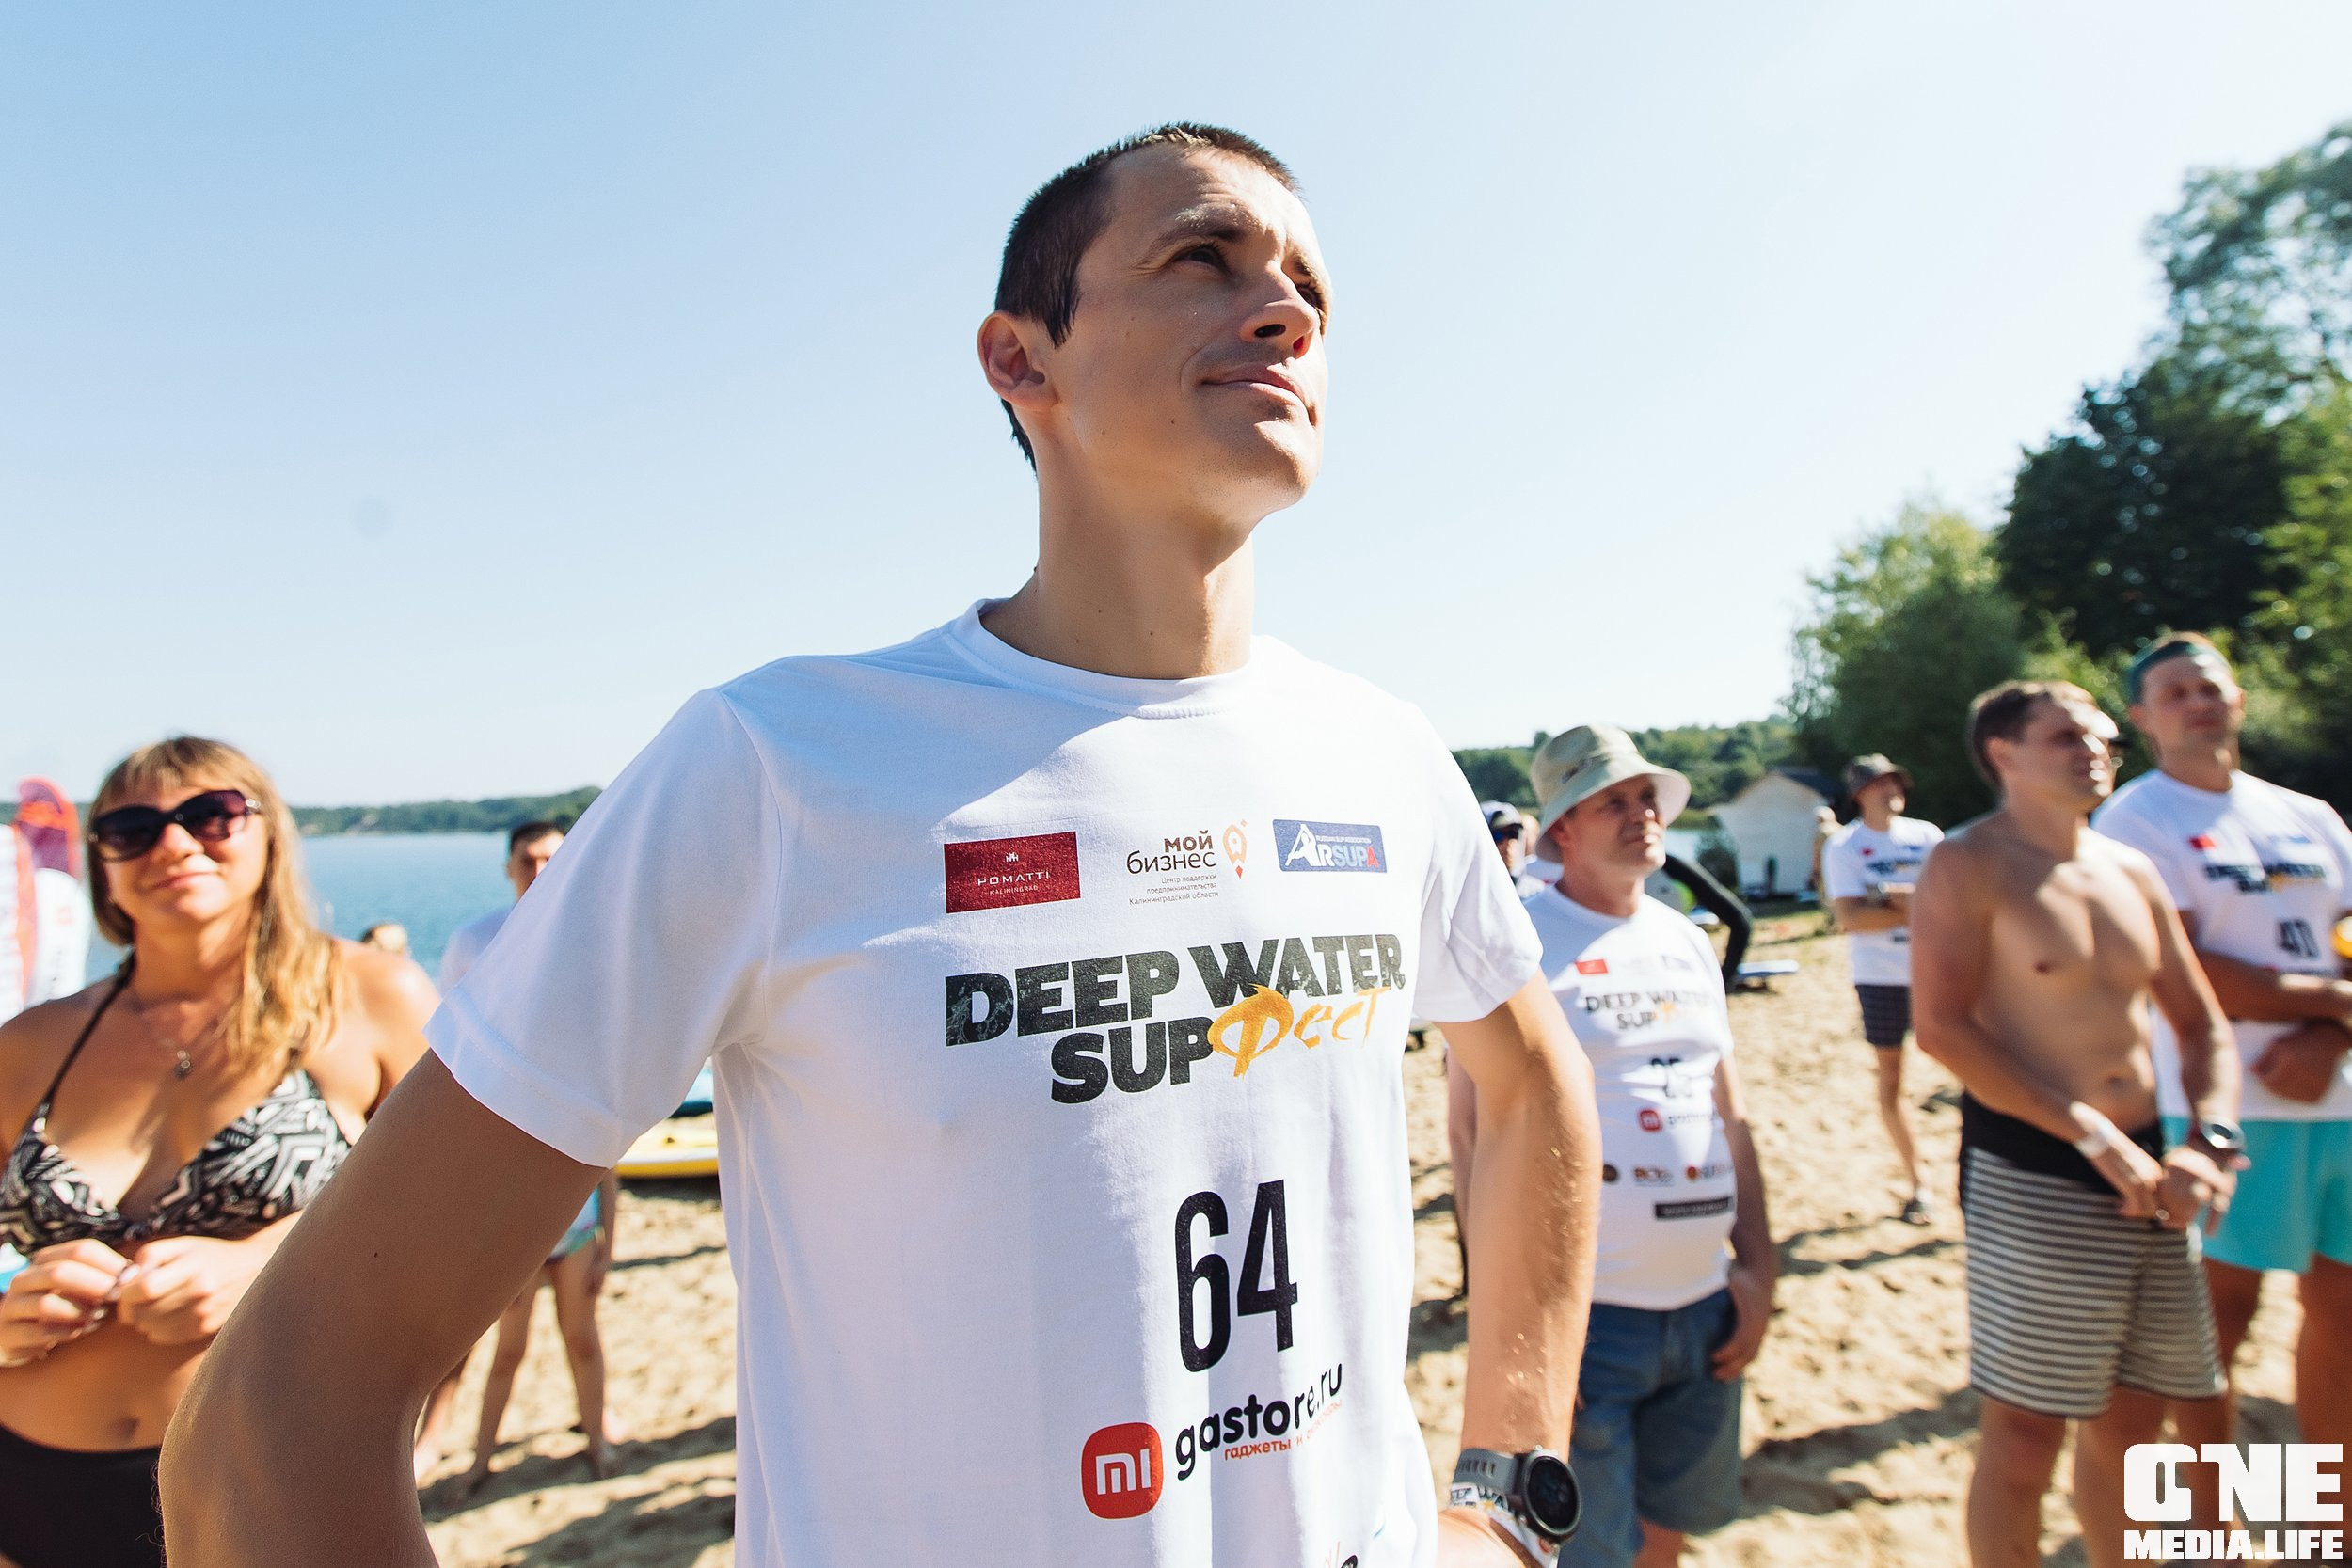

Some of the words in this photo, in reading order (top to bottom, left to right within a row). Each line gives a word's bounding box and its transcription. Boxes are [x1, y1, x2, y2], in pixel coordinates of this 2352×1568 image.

[1164, 830, 1214, 853] мой
[1126, 849, 1216, 875] бизнес
[977, 871, 1050, 886] POMATTI
[989, 885, 1039, 895] KALININGRAD
[1146, 882, 1217, 895] предпринимательства
[1182, 874, 1216, 883] поддержки
[1128, 895, 1191, 906] Калининградской
[1192, 892, 1219, 900] области
[945, 950, 1181, 1048] DEEP
[1186, 933, 1407, 1009] WATER
[1050, 1016, 1216, 1106] SUP
[1173, 1179, 1299, 1373] 64
[1174, 1362, 1343, 1481] gastore.ru
[1224, 1439, 1292, 1462] гаджеты
